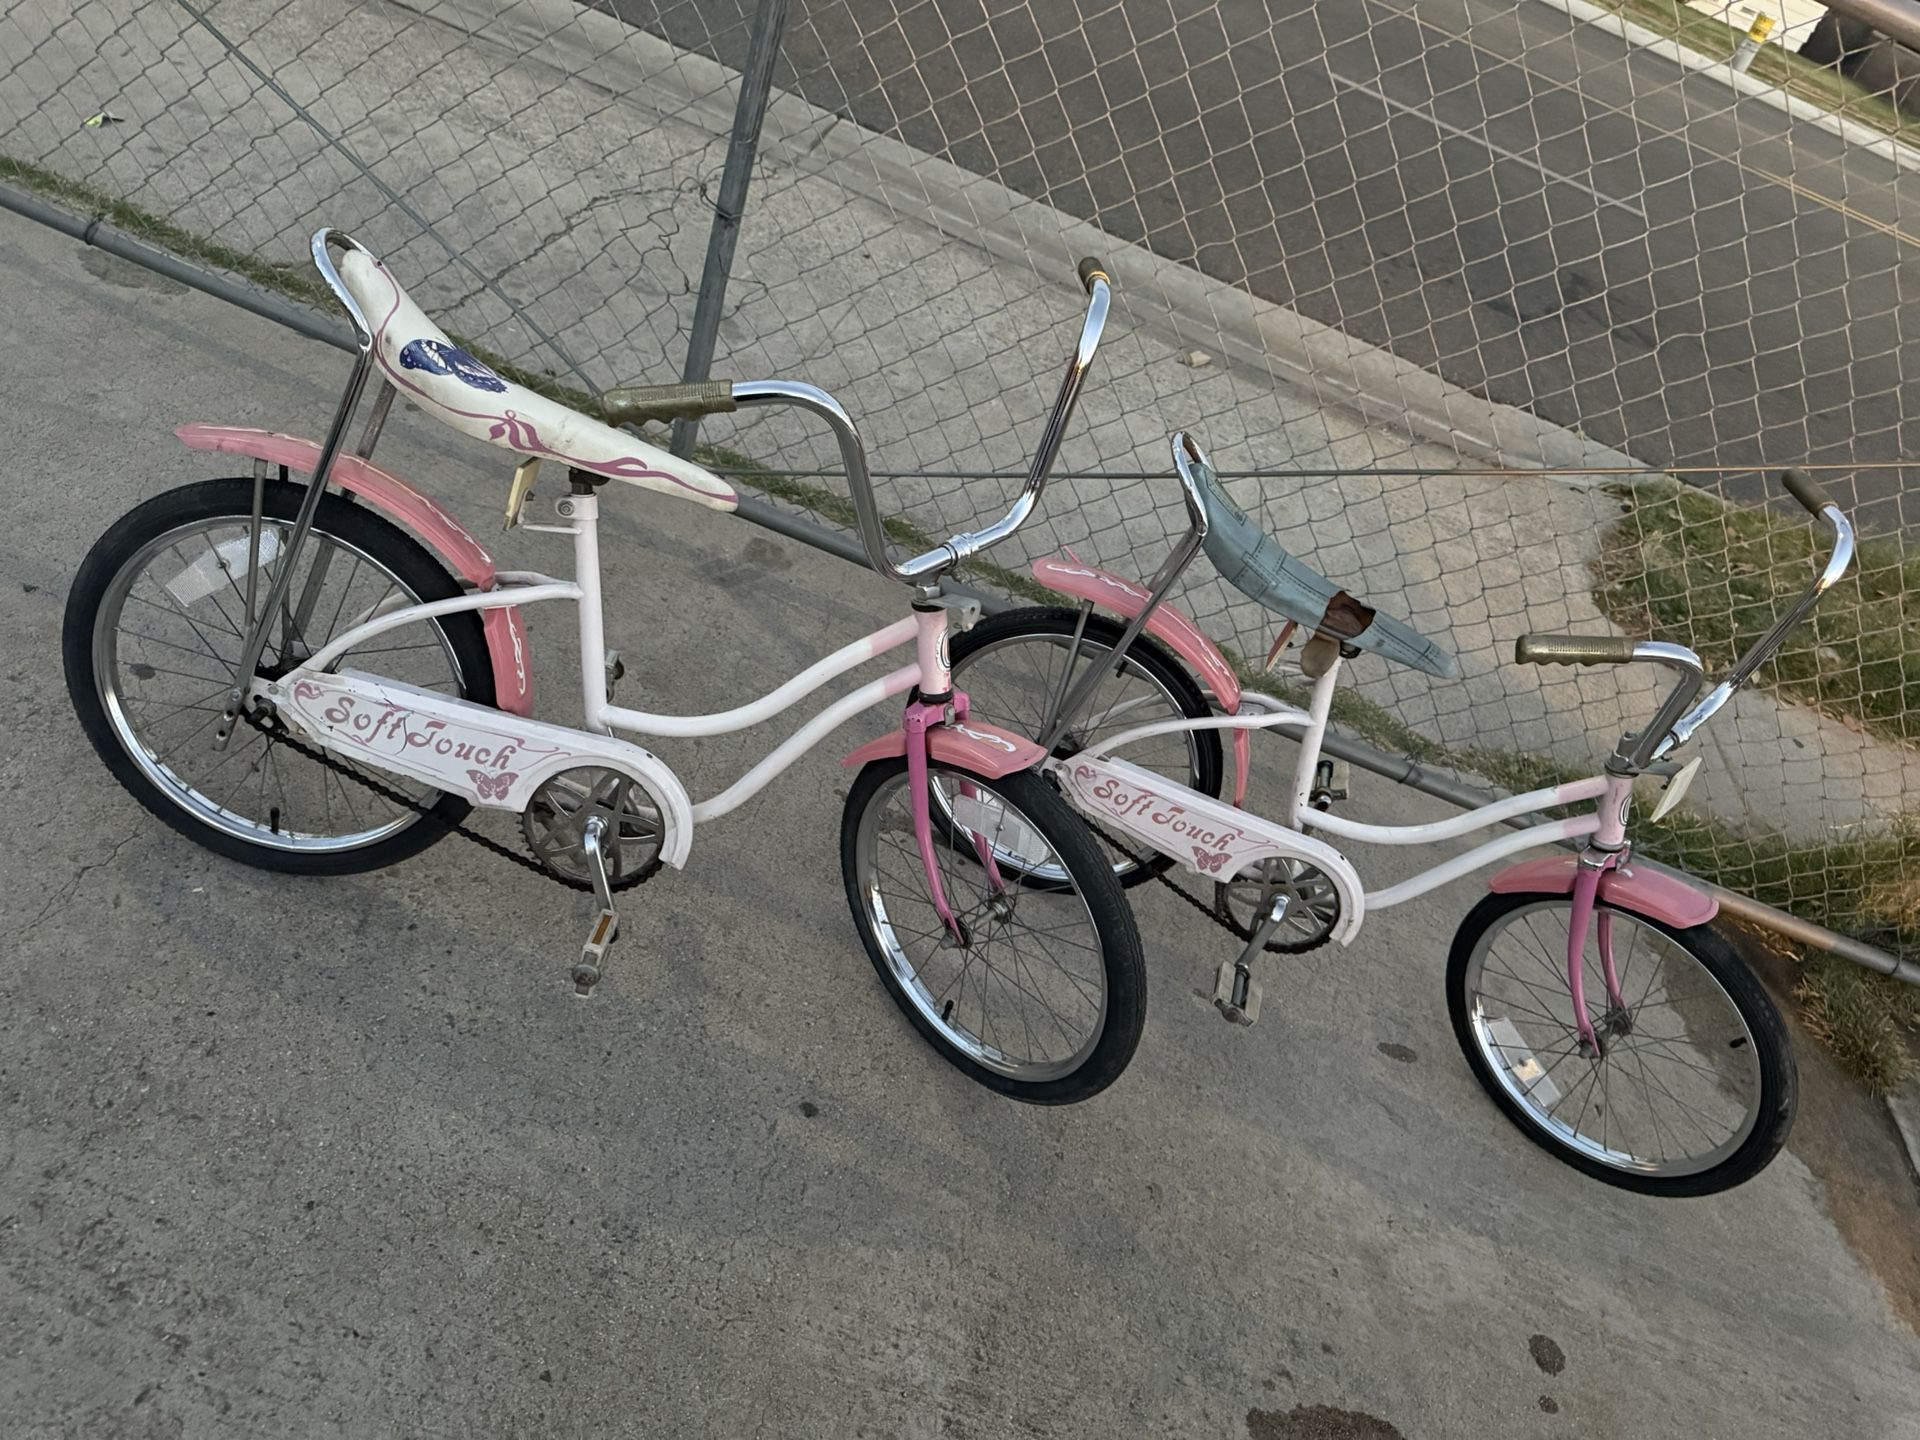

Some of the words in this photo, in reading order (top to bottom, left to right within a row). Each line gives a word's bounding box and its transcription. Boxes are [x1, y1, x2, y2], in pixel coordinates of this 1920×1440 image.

[324, 696, 405, 744] Soft
[406, 719, 518, 770] Touch
[1093, 779, 1156, 816] Soft
[1151, 806, 1236, 851] Touch
